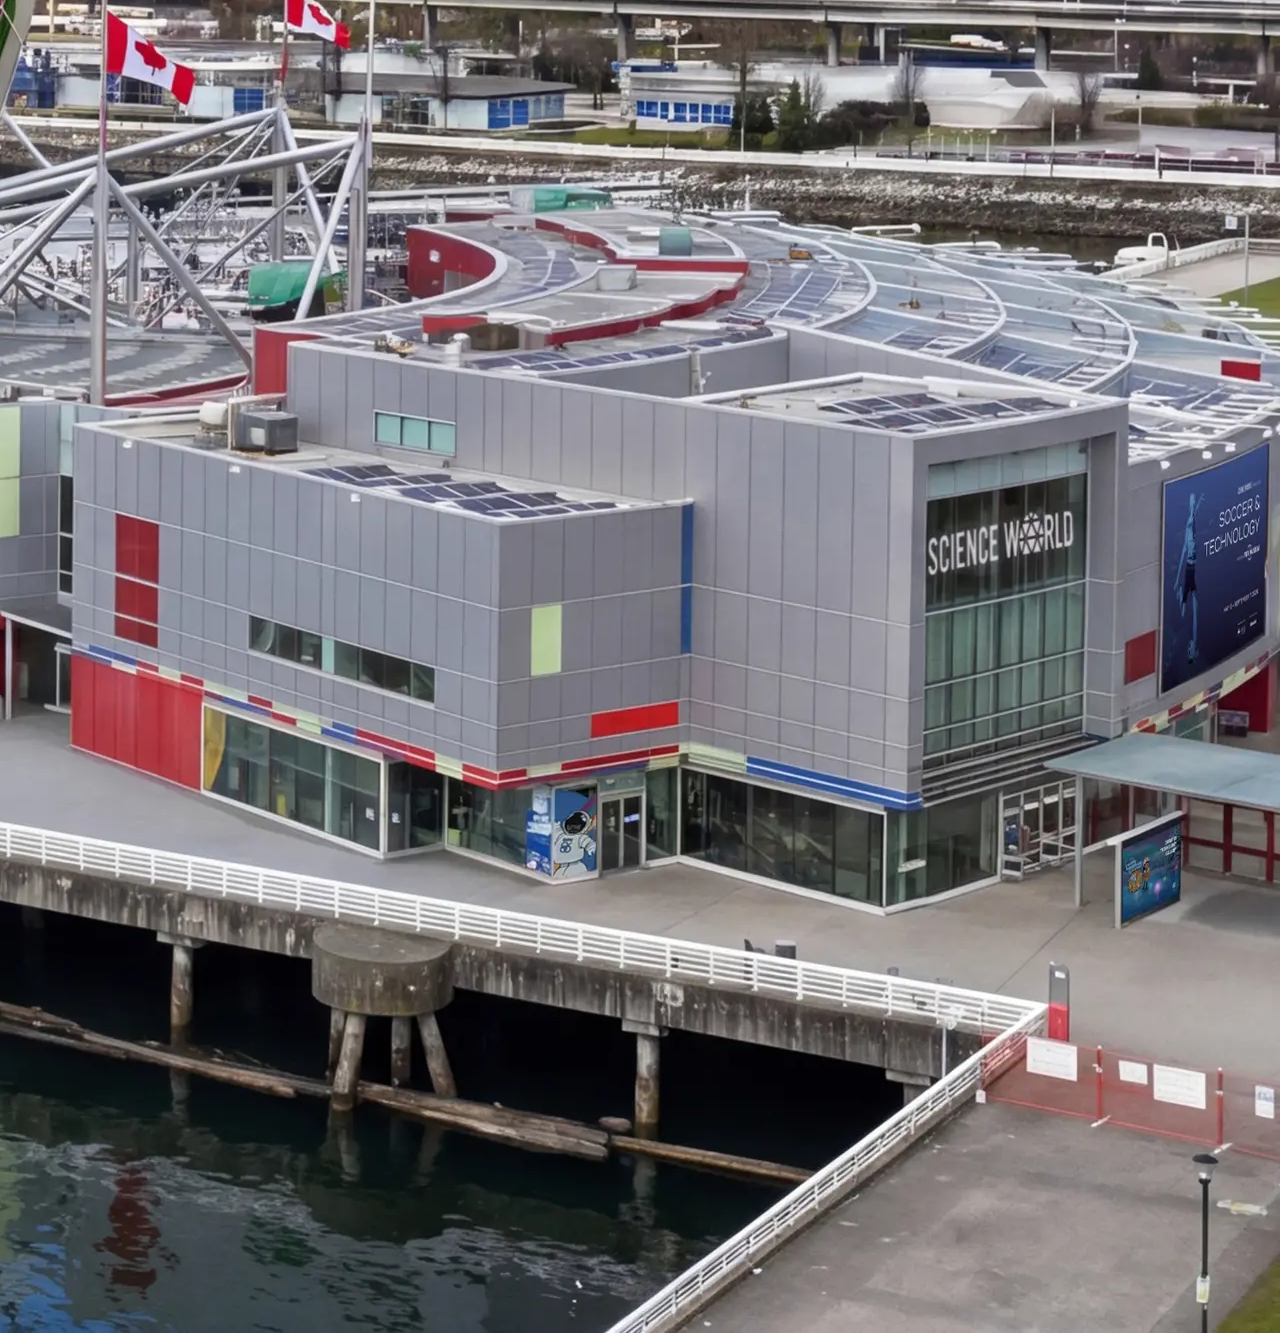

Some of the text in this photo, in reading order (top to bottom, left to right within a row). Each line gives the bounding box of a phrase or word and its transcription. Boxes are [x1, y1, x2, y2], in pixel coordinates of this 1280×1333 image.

[1219, 494, 1261, 528] SOCCER &
[928, 524, 999, 576] SCIENCE
[1203, 516, 1261, 557] TECHNOLOGY
